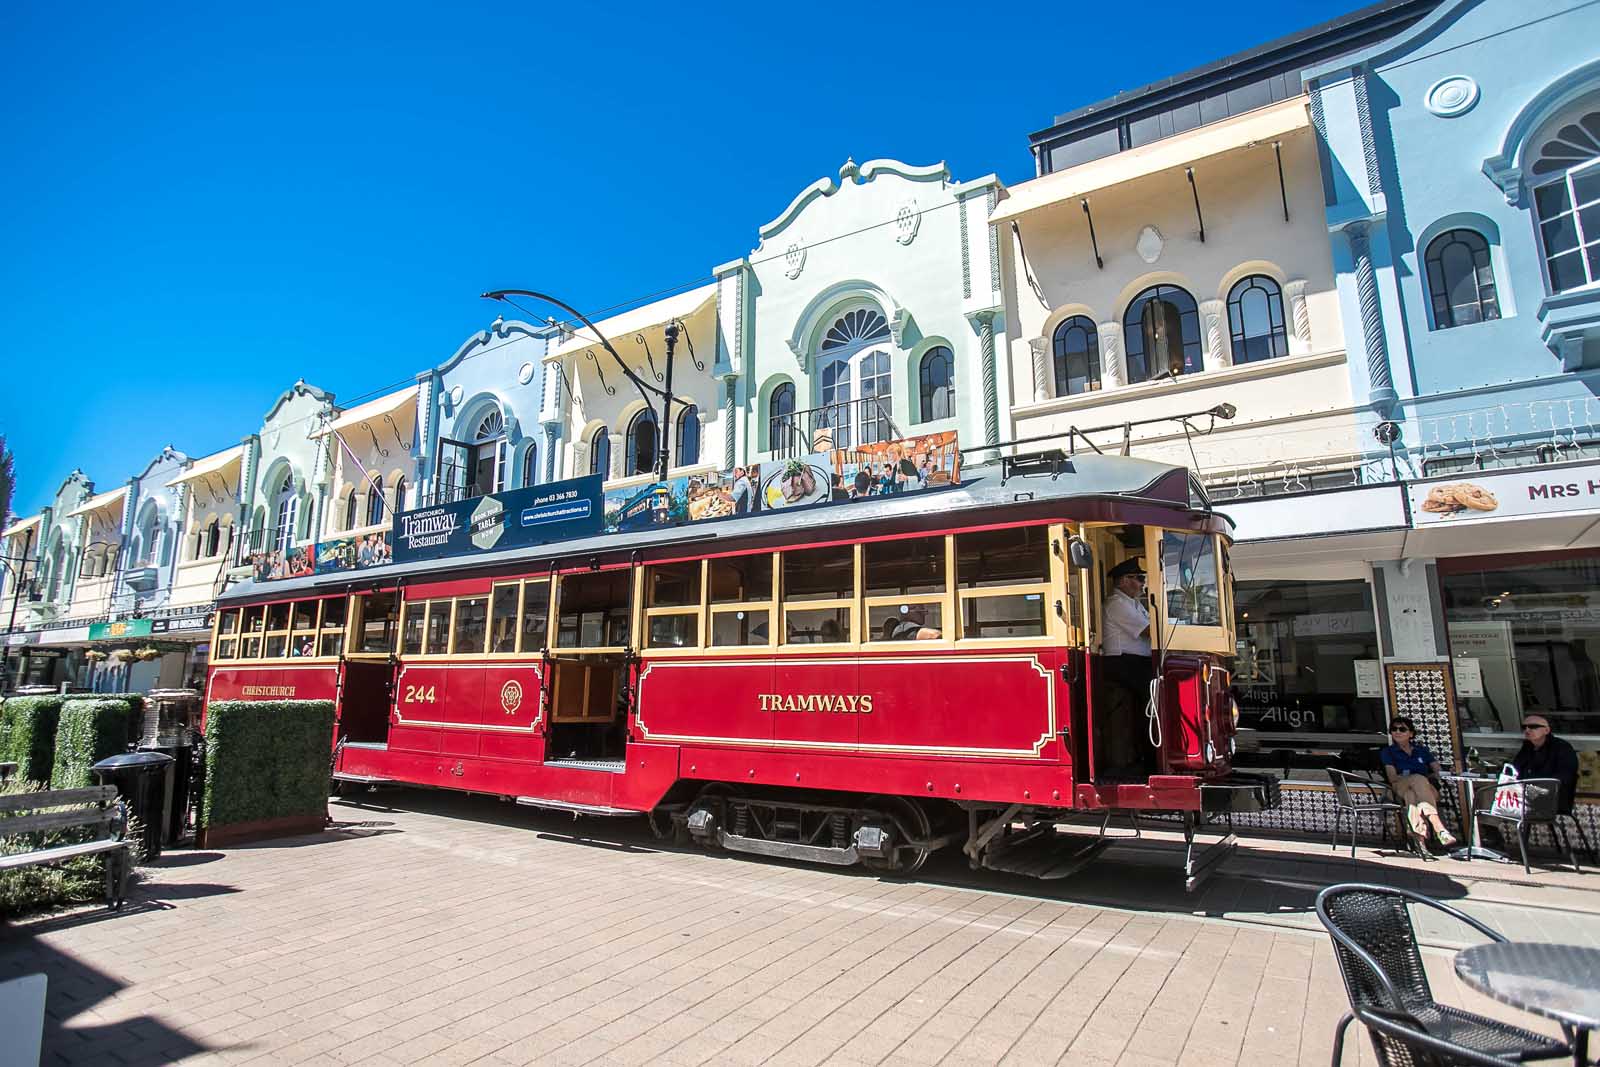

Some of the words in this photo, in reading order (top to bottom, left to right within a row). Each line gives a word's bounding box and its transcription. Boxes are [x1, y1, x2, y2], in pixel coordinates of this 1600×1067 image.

[534, 497, 548, 506] phone
[549, 494, 555, 502] 03
[1528, 483, 1580, 500] MRS
[413, 508, 445, 520] CHRISTCHURCH
[402, 513, 457, 536] Tramway
[477, 517, 496, 531] TABLE
[408, 532, 449, 549] Restaurant
[242, 685, 296, 697] CHRISTCHURCH
[404, 685, 436, 704] 244
[758, 693, 873, 713] TRAMWAYS
[1260, 706, 1315, 728] Align
